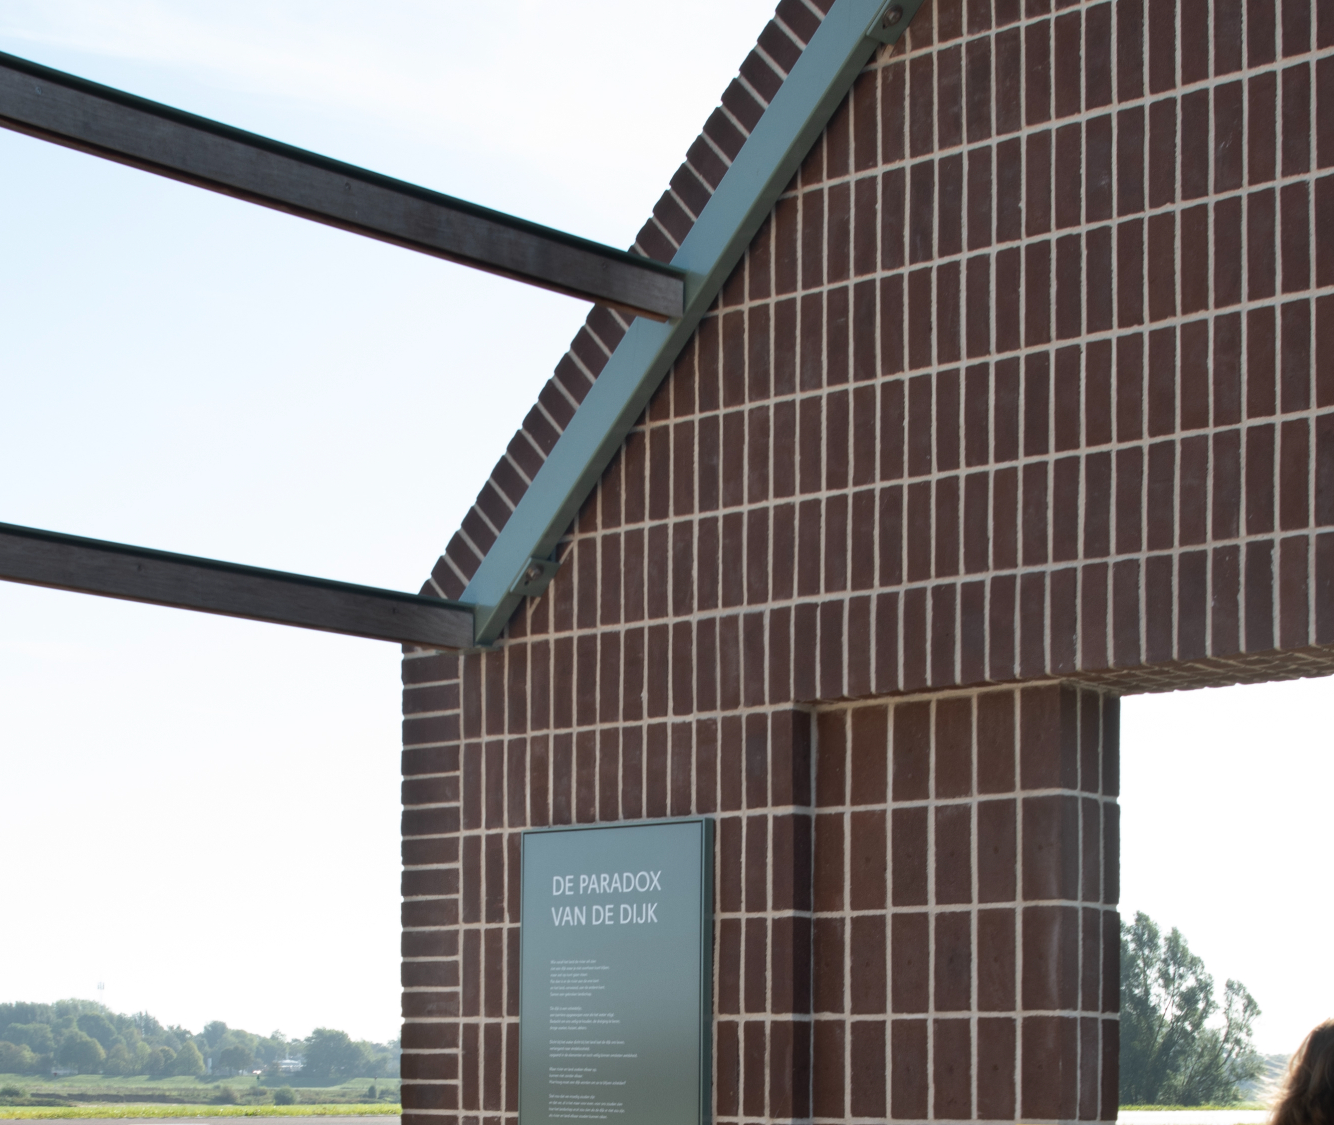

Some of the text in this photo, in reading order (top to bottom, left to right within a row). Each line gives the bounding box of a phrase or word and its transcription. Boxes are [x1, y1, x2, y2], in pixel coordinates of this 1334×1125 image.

[552, 870, 662, 896] DE PARADOX
[551, 902, 658, 927] VAN DE DIJK
